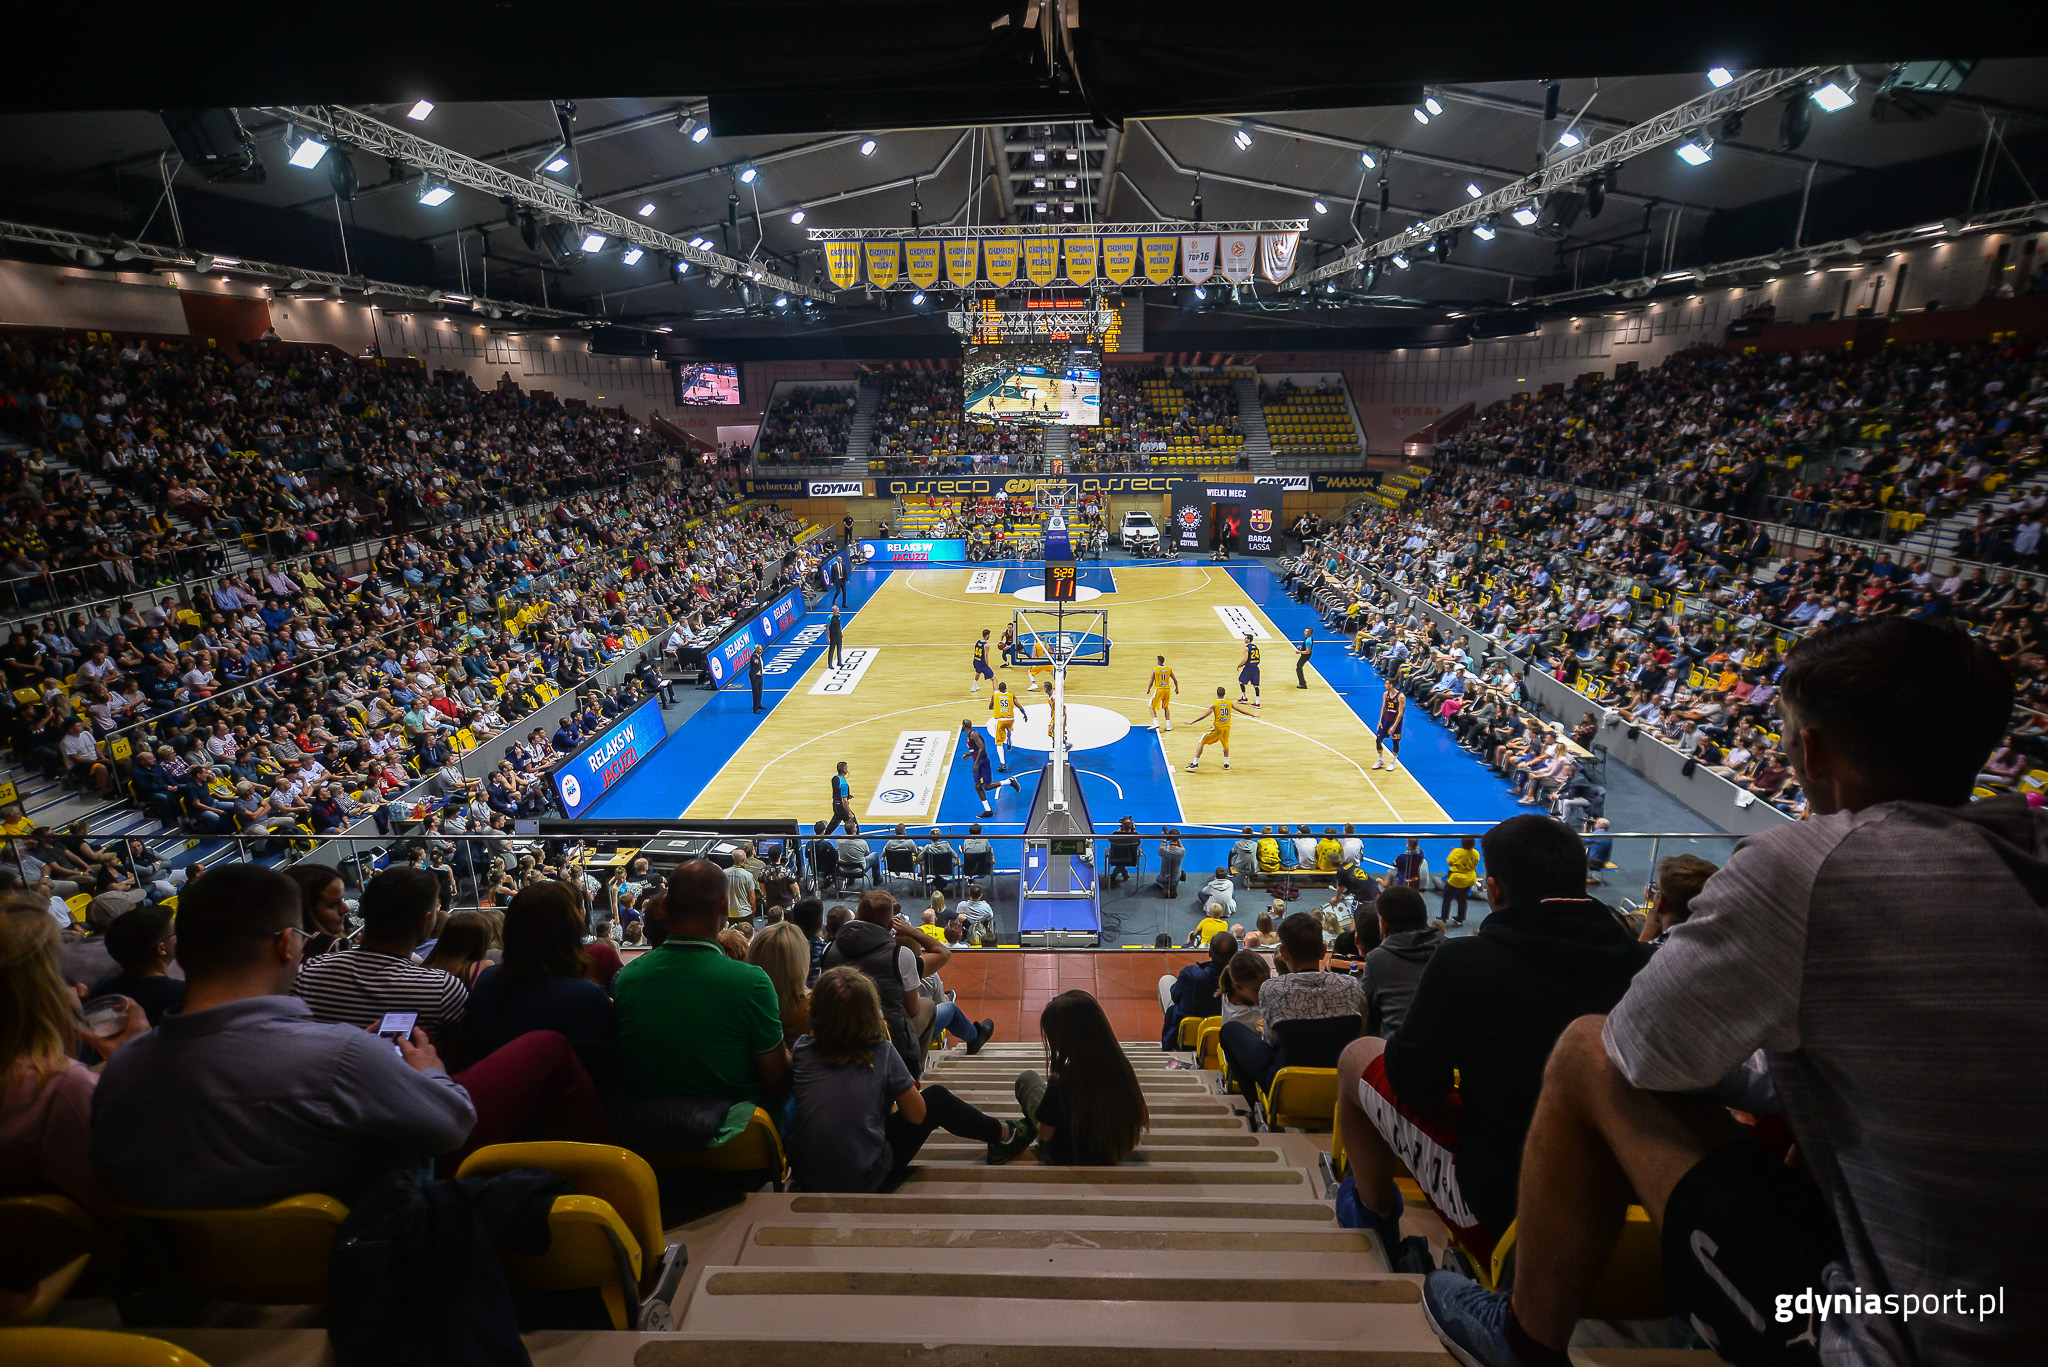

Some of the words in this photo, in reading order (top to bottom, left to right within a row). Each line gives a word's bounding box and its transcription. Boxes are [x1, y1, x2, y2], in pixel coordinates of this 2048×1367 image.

[1200, 252, 1209, 261] 16
[755, 481, 802, 493] wyborcza.pl
[890, 481, 989, 493] asseco
[1327, 477, 1374, 488] MAXXX
[811, 484, 860, 495] GDYNIA
[1207, 489, 1227, 497] WIELKI
[1229, 489, 1246, 497] MECZ
[1248, 535, 1272, 544] BARÇA
[887, 543, 922, 552] RELAKS
[922, 543, 933, 551] W
[892, 553, 928, 561] JACUZZI
[1054, 568, 1074, 578] 5:29
[1056, 580, 1074, 597] 11
[773, 603, 788, 620] RELAKS
[786, 598, 793, 609] W
[779, 612, 795, 631] JACUZZI
[790, 623, 827, 645] ARENA
[725, 640, 745, 660] RELAKS
[743, 631, 750, 645] W
[975, 647, 982, 657] 44
[1251, 649, 1259, 659] 24
[732, 647, 752, 672] JACUZZI
[762, 646, 810, 675] GDYNIA
[1220, 708, 1228, 716] 30
[117, 742, 128, 754] G1
[588, 733, 625, 773] RELAKS
[622, 724, 636, 744] W
[894, 737, 926, 775] PLICHTA
[601, 746, 638, 788] JACUZZI
[0, 788, 13, 798] G2
